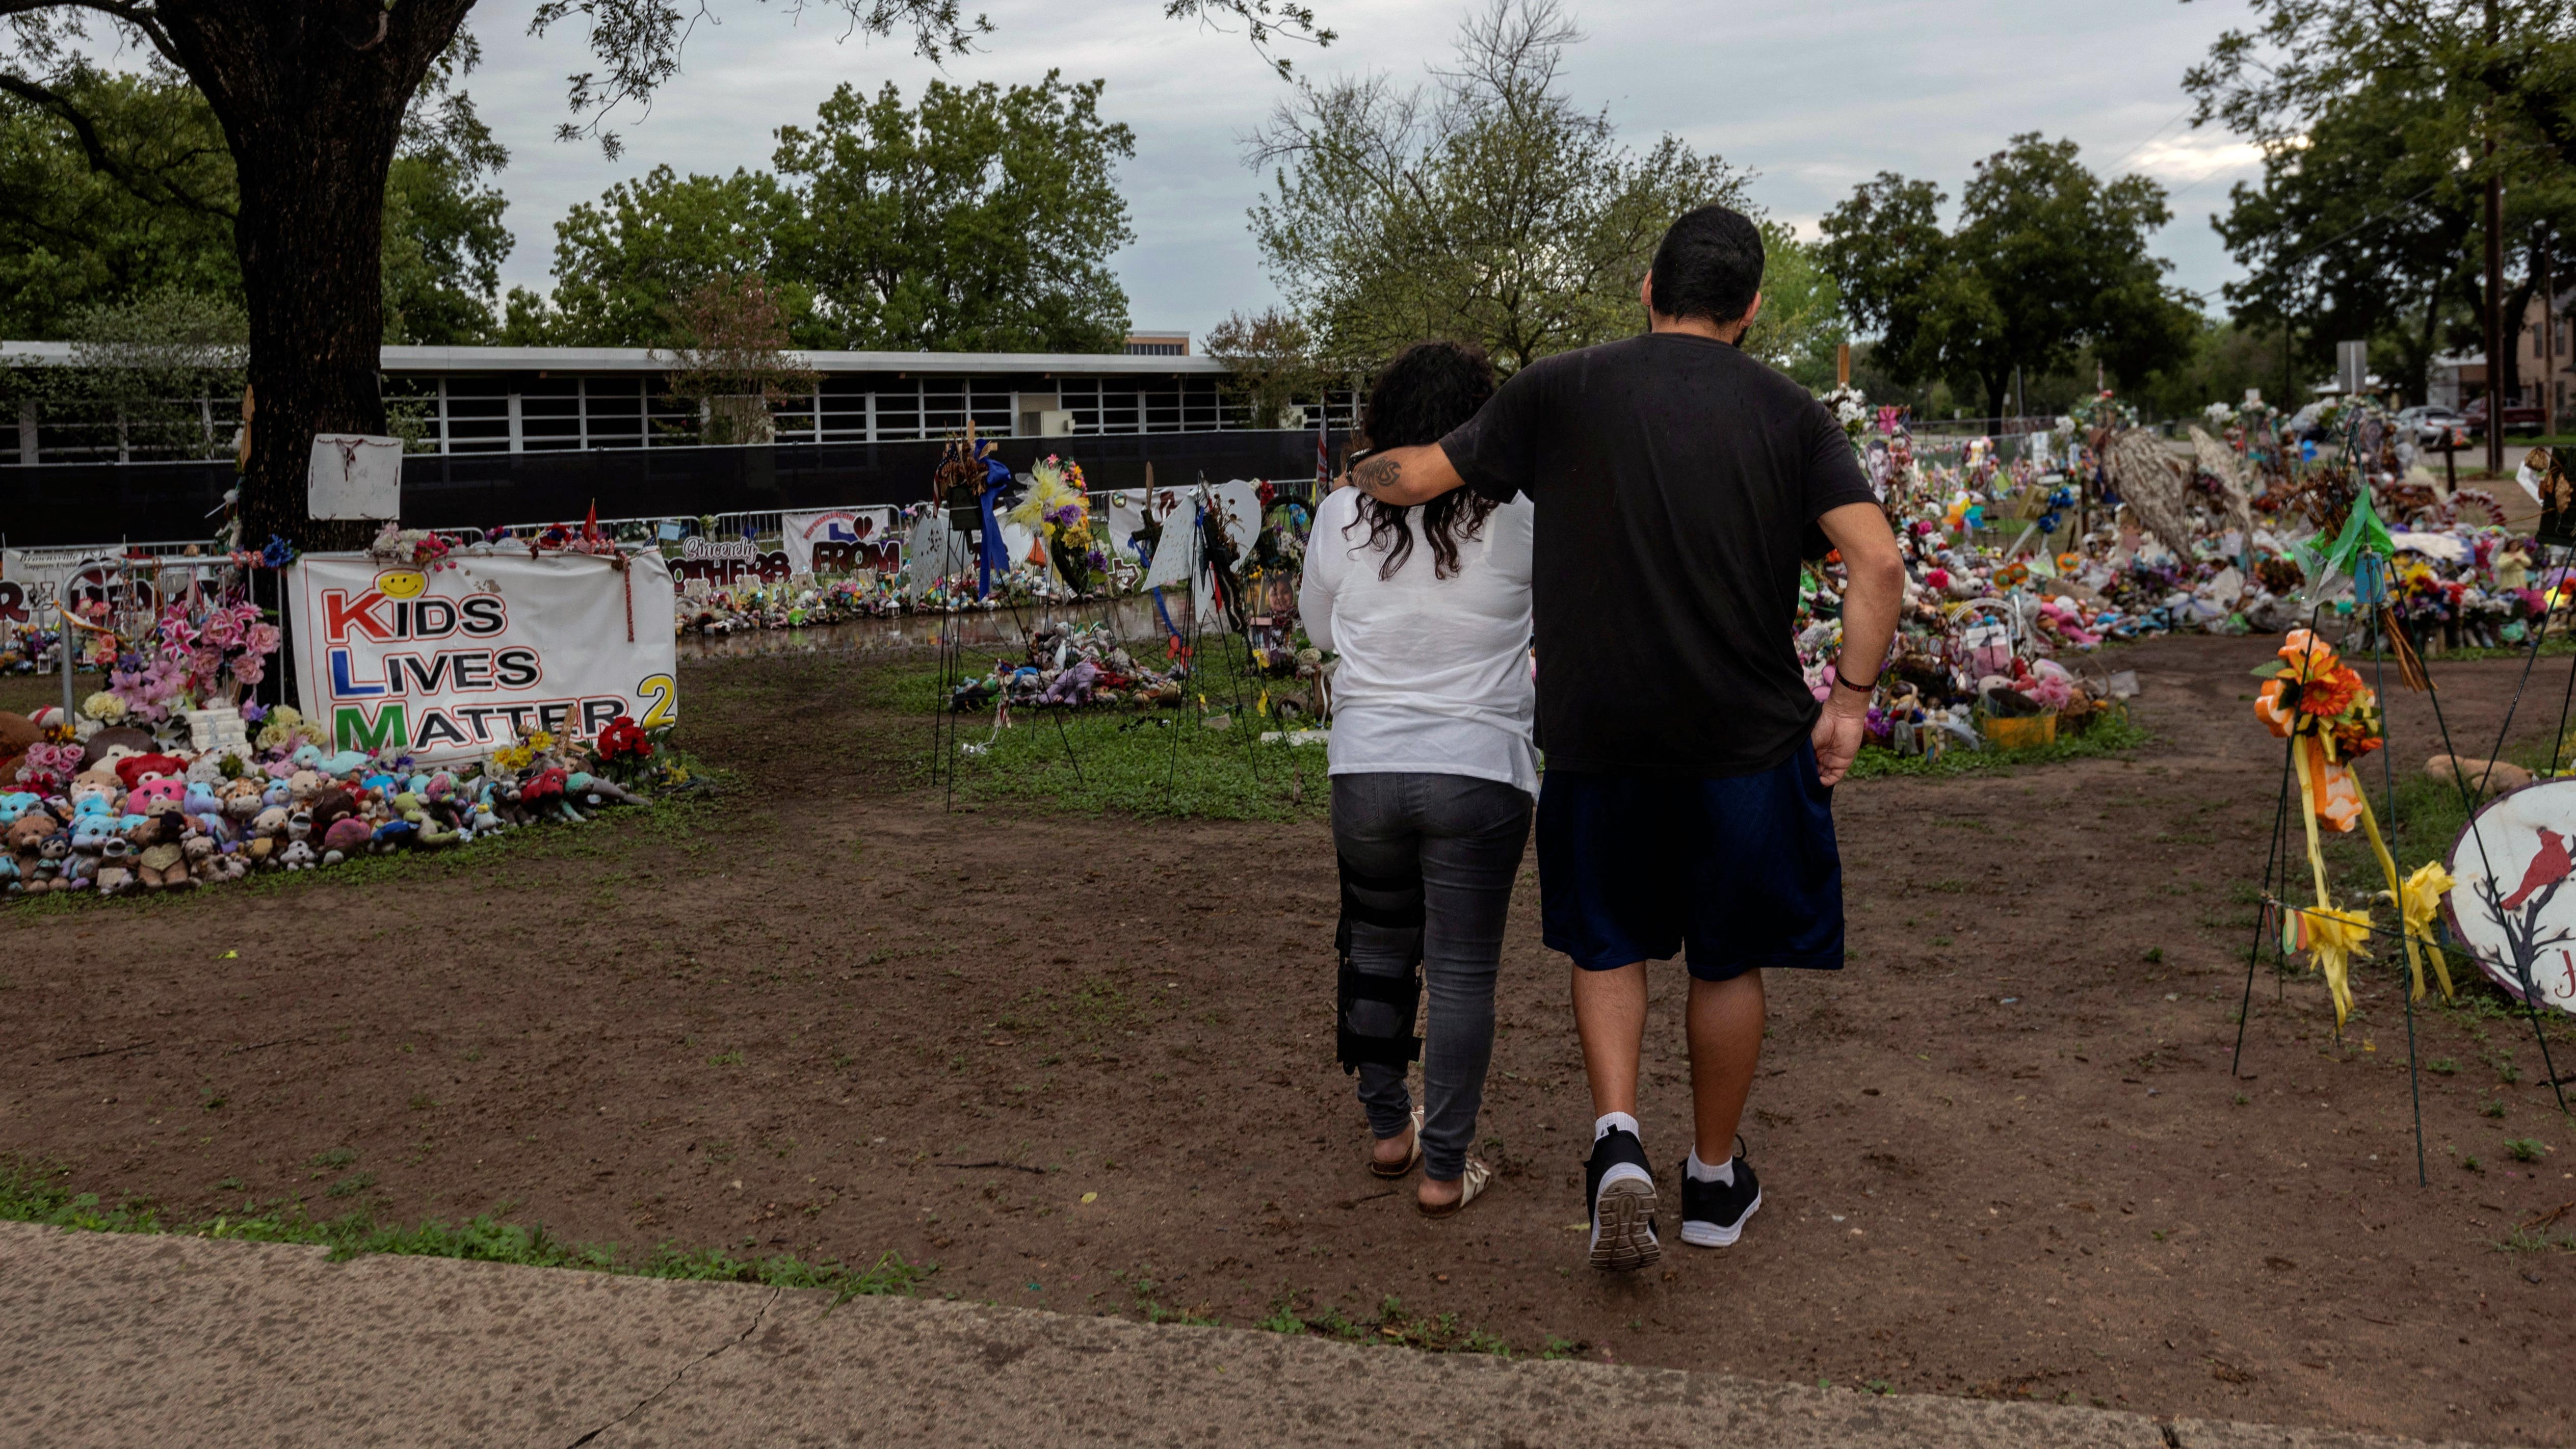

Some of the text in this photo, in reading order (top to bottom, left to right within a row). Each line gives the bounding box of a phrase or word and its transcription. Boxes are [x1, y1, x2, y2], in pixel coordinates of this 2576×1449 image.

[683, 536, 758, 565] Sincerely
[812, 540, 901, 574] FROM
[326, 592, 504, 640] KIDS
[331, 650, 539, 695] LIVES
[336, 673, 676, 752] MATTER 2
